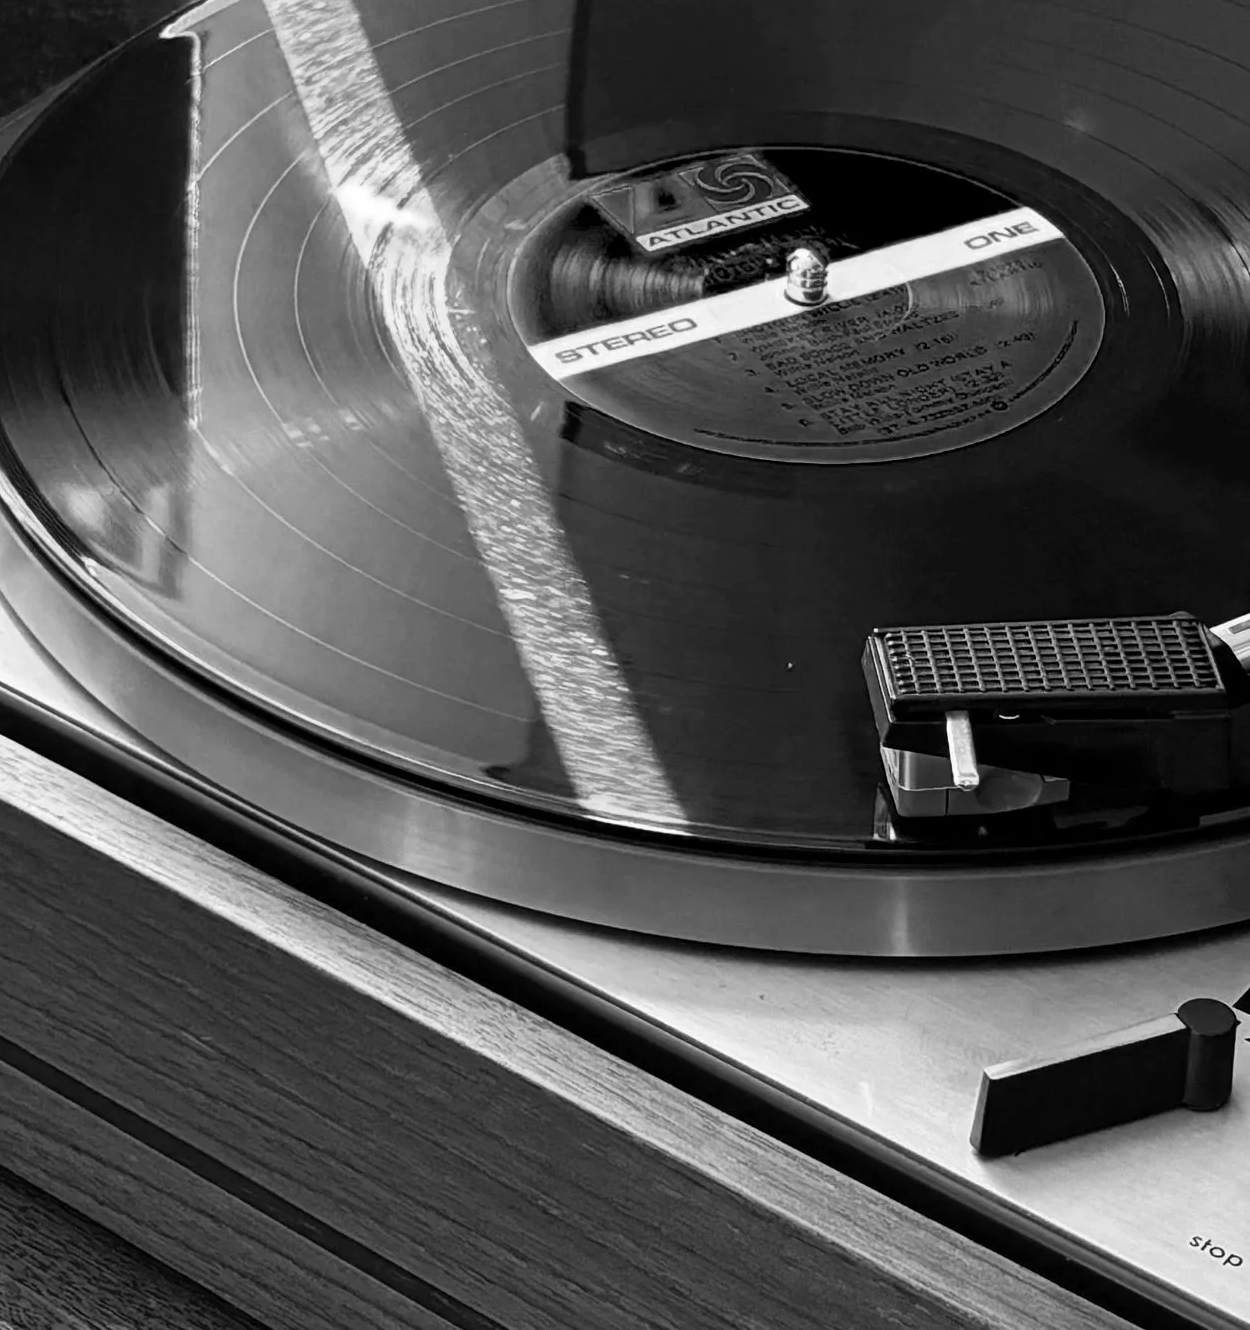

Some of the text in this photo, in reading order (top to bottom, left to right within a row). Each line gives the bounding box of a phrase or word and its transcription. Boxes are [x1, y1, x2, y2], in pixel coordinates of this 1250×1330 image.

[646, 197, 802, 246] ATLANTIC
[554, 317, 698, 364] STEREO
[963, 221, 1040, 250] ONE
[1189, 1235, 1243, 1267] stop
